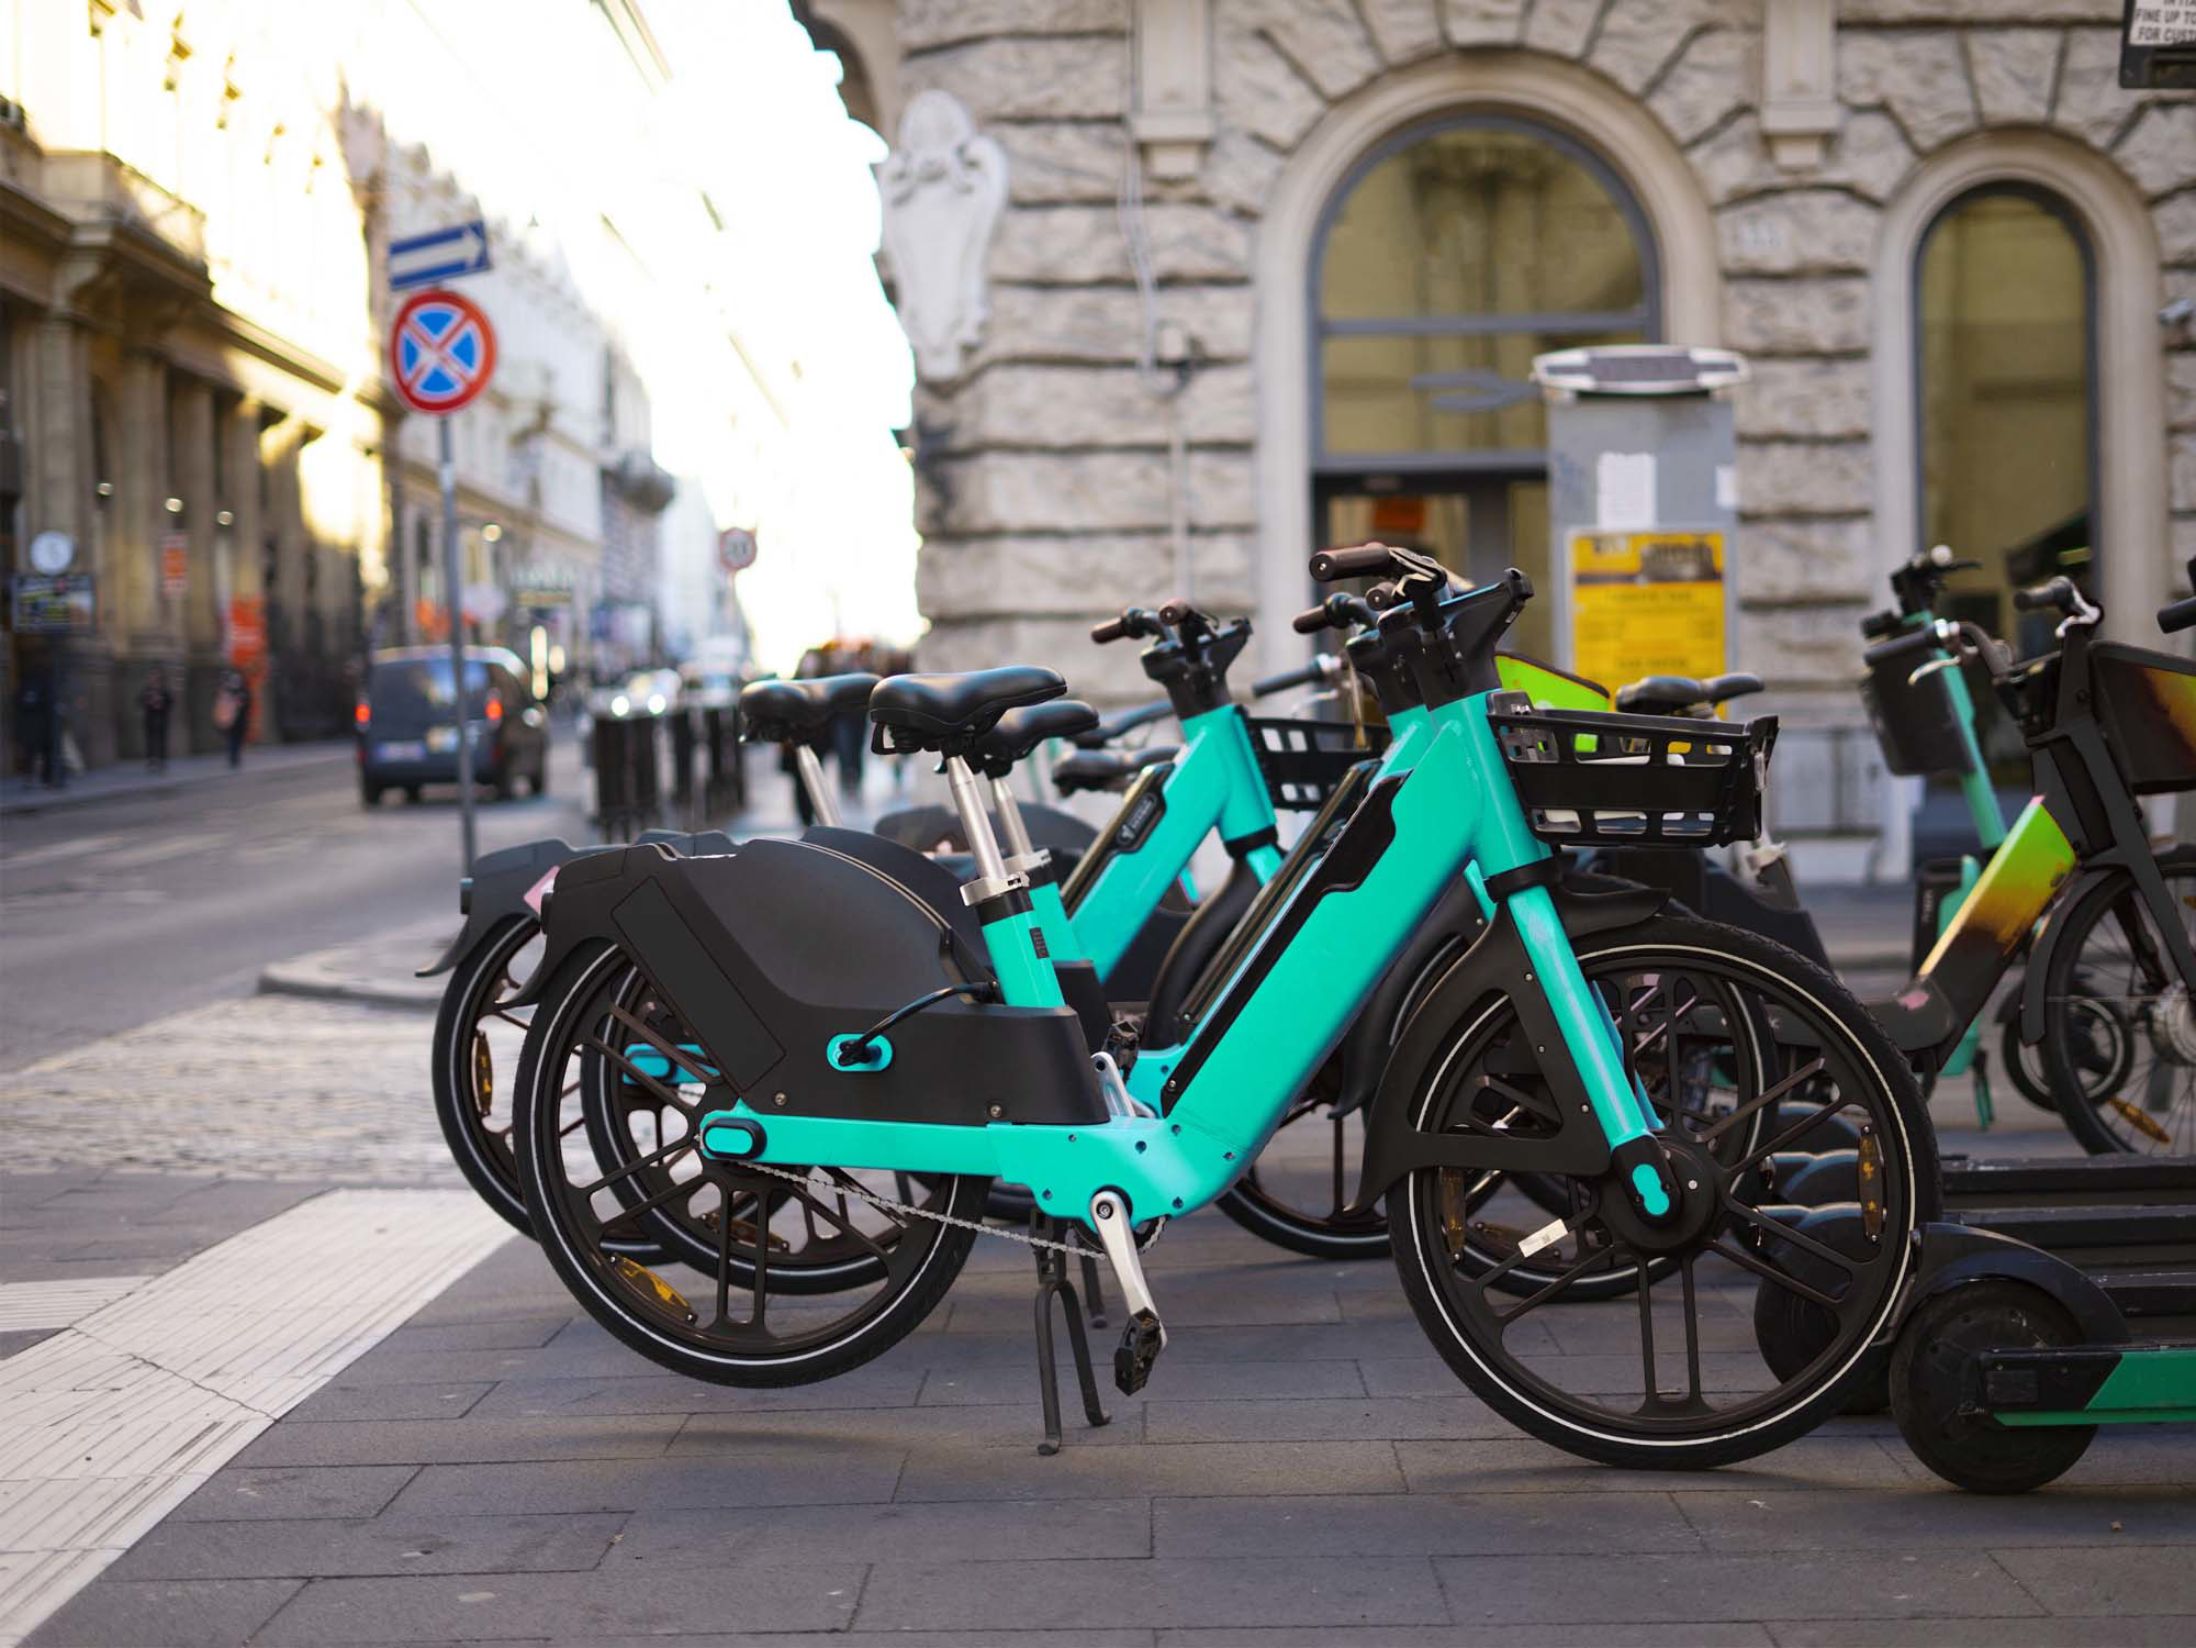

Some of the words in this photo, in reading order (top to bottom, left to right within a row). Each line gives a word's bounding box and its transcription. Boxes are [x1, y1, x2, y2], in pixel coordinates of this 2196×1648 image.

[2135, 8, 2161, 22] FINE
[2165, 10, 2181, 24] UP
[2138, 26, 2160, 41] FOR
